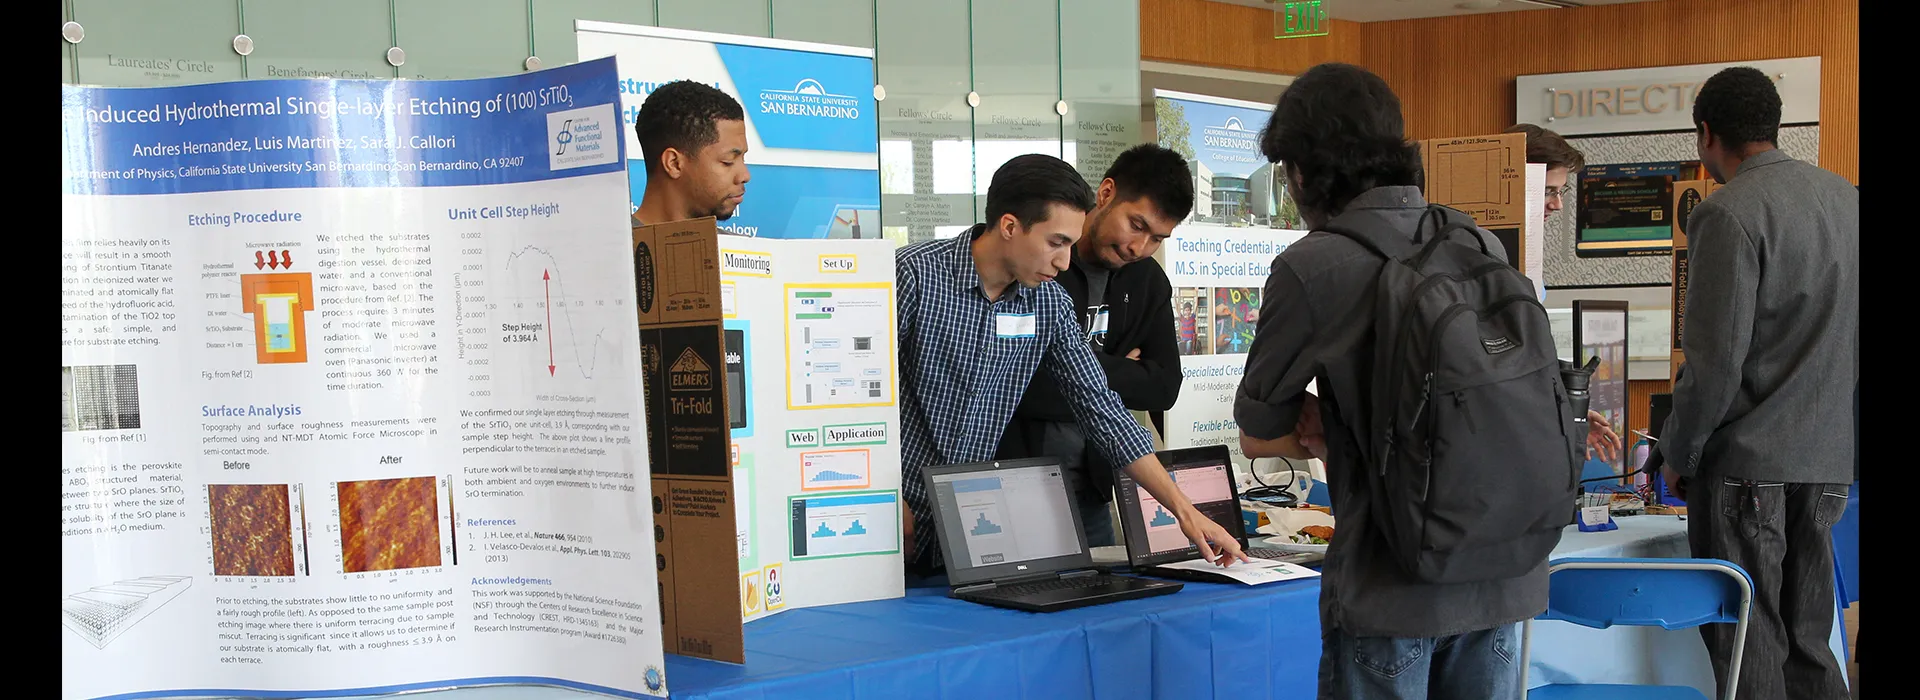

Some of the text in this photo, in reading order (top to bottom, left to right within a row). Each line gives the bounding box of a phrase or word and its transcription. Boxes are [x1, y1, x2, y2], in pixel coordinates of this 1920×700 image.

[1285, 1, 1321, 33] EXIT
[108, 54, 215, 74] Laureates' Circle
[760, 93, 859, 107] CALIFORNIA STATE UNIVERSITY
[165, 96, 281, 127] Hydrothermal
[409, 96, 481, 119] Etching
[485, 93, 503, 113] of
[506, 89, 537, 114] (100)
[760, 101, 860, 120] SAN BERNARDINO
[898, 107, 953, 121] Fellows' Circle
[1078, 120, 1125, 133] Fellows' Circle
[132, 143, 181, 157] Andres
[183, 138, 252, 153] Hernandez,
[254, 136, 283, 151] Luis
[287, 135, 357, 151] Martinez,
[360, 136, 391, 150] Sara
[409, 135, 456, 149] Callori
[1204, 136, 1219, 146] SAN
[122, 167, 135, 180] of
[137, 167, 178, 182] Physics,
[179, 164, 221, 179] California
[222, 162, 248, 175] State
[248, 160, 303, 175] University
[305, 160, 326, 172] San
[420, 158, 482, 173] Bernardino,
[483, 159, 500, 170] CA
[500, 156, 525, 168] 92407
[188, 209, 302, 228] Etching Procedure
[448, 202, 560, 221] Unit Cell Step Height
[1176, 238, 1221, 256] Teaching
[1224, 239, 1273, 255] Credential
[141, 263, 172, 271] Titanate
[724, 253, 771, 275] Monitoring
[823, 259, 853, 270] Set Up
[1175, 262, 1198, 276] M.S.
[1199, 262, 1209, 275] in
[1211, 262, 1246, 279] Special
[502, 322, 543, 332] Step Height
[503, 334, 511, 343] of
[512, 334, 531, 343] 3.964
[215, 371, 230, 379] from
[231, 370, 242, 379] Ref
[243, 370, 253, 379] [2]
[1182, 365, 1245, 380] Specialized Cred
[672, 373, 710, 387] ELMER'S
[1193, 382, 1234, 392] Mild-Moderate
[202, 404, 302, 418] Surface Analysis
[671, 398, 712, 415] Tri-Fold
[202, 417, 437, 433] Topography and surface roughness measurements were
[1192, 420, 1222, 432] Flexible
[203, 427, 438, 445] performed using and NT-MDT Atomic Force Microscope in
[791, 428, 885, 443] Web Application
[203, 447, 269, 456] semi-contact mode.
[142, 462, 183, 472] perovskite
[223, 460, 250, 470] Before
[379, 455, 402, 465] After
[467, 518, 517, 527] References
[471, 576, 552, 587] Acknowledgements
[474, 624, 560, 635] Research Instrumentation
